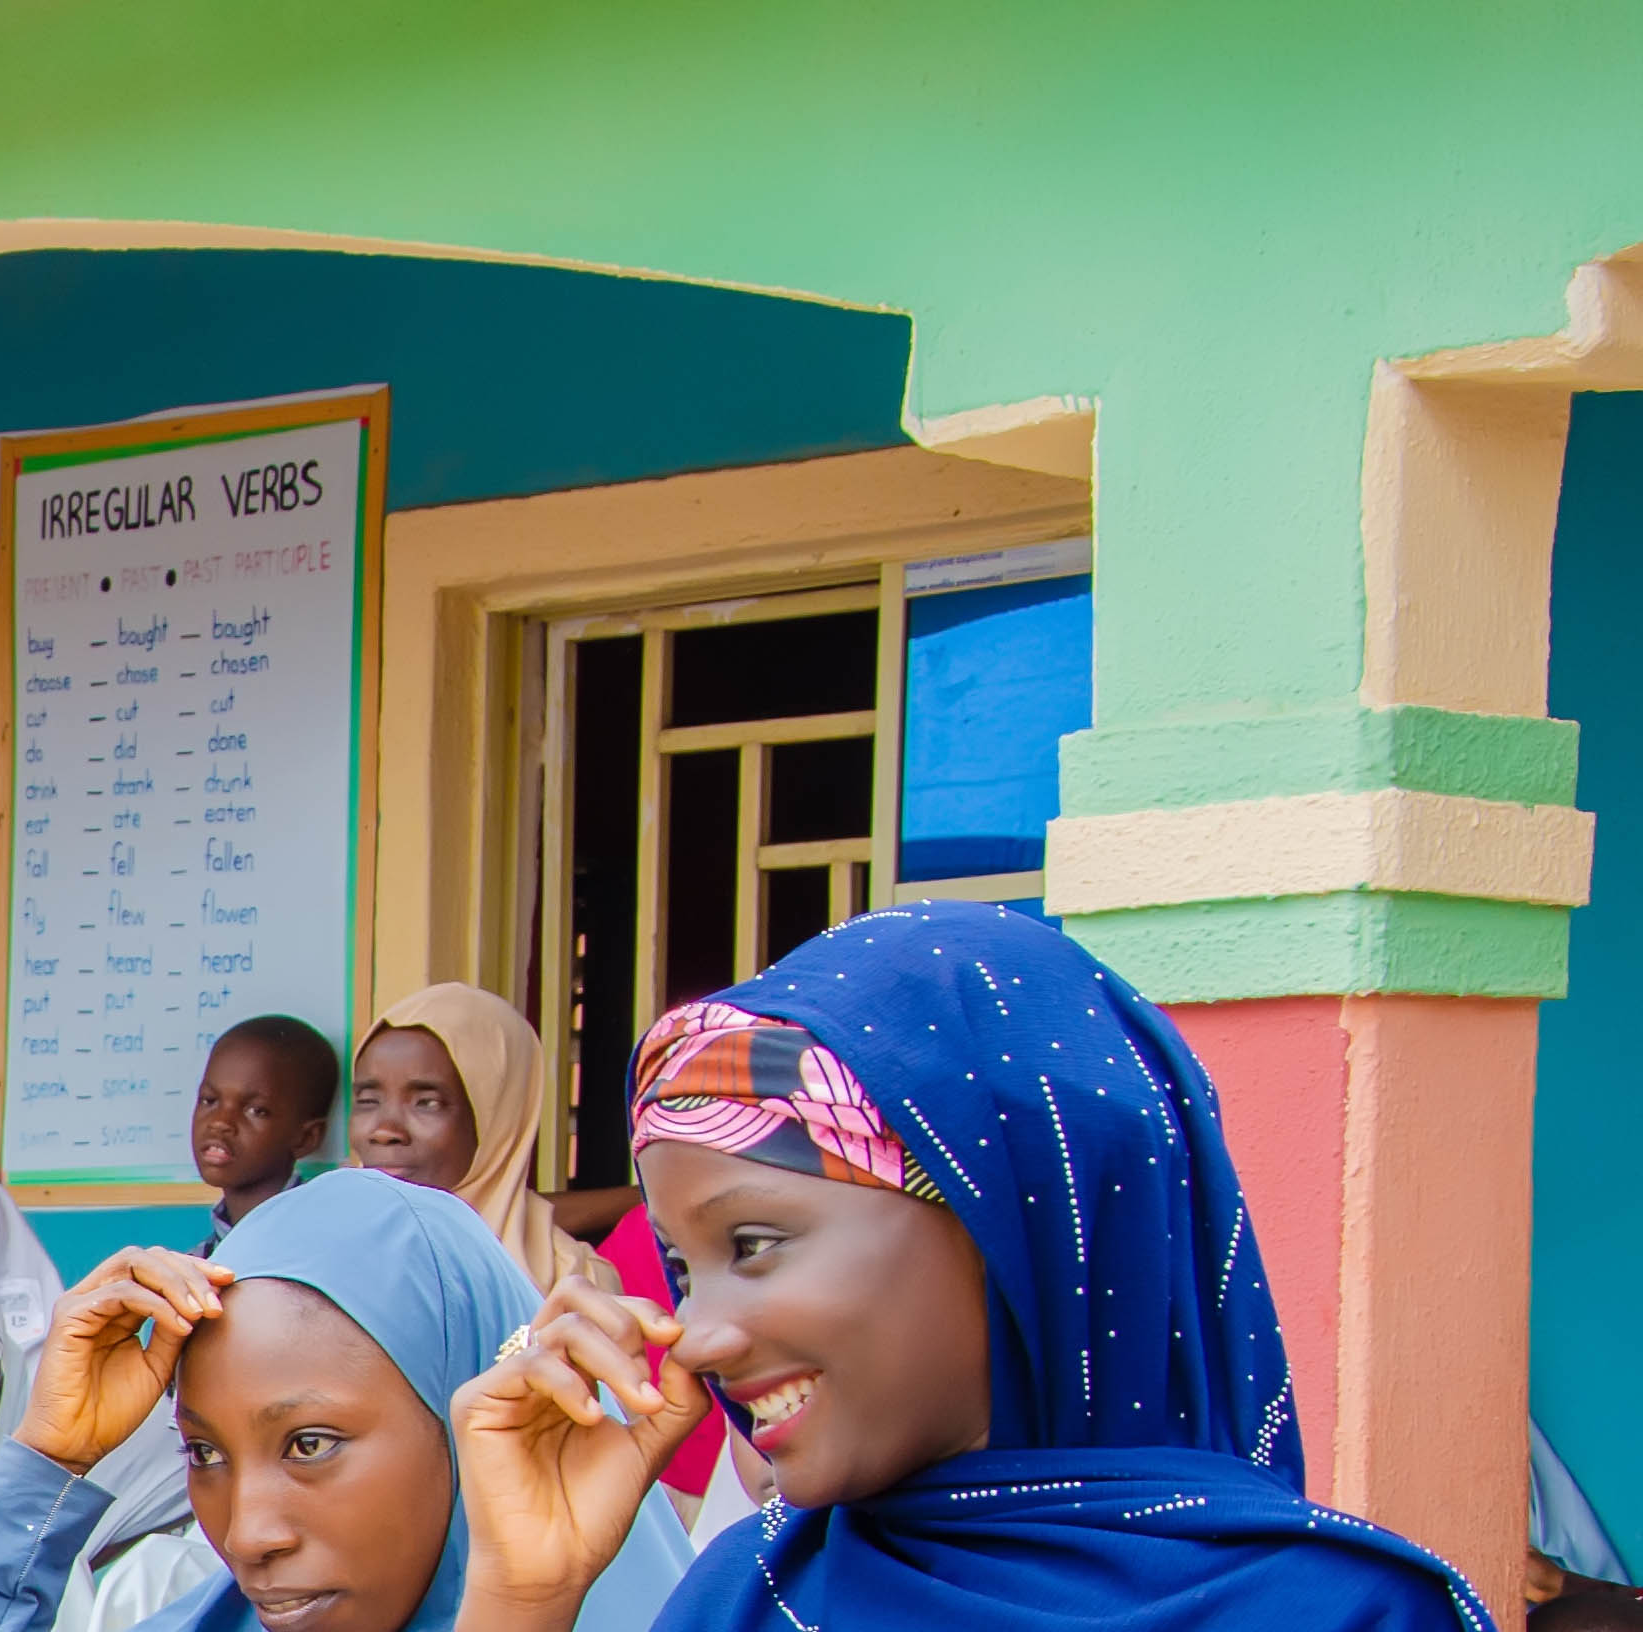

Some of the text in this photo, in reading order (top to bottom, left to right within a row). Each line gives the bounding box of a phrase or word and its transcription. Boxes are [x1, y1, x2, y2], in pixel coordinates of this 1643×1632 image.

[40, 460, 323, 540] IRREGULAR VERBS
[182, 555, 223, 585] PAST
[234, 540, 332, 577] PARTICIPLE
[27, 606, 271, 660] buy bought bought
[25, 651, 270, 693] choose chose chosen
[25, 688, 235, 728] cut cut cut
[25, 723, 248, 764] do did done
[25, 760, 253, 800] drink drank drunk
[25, 800, 256, 836] eat ate eaten
[25, 837, 255, 878] fall fell fallen
[23, 896, 47, 936] fly
[108, 888, 146, 926] flew
[25, 938, 253, 977] hear heard heard
[23, 984, 231, 1023] put put put
[22, 1026, 60, 1056] read
[103, 1023, 145, 1053] read
[21, 1074, 68, 1107] speak
